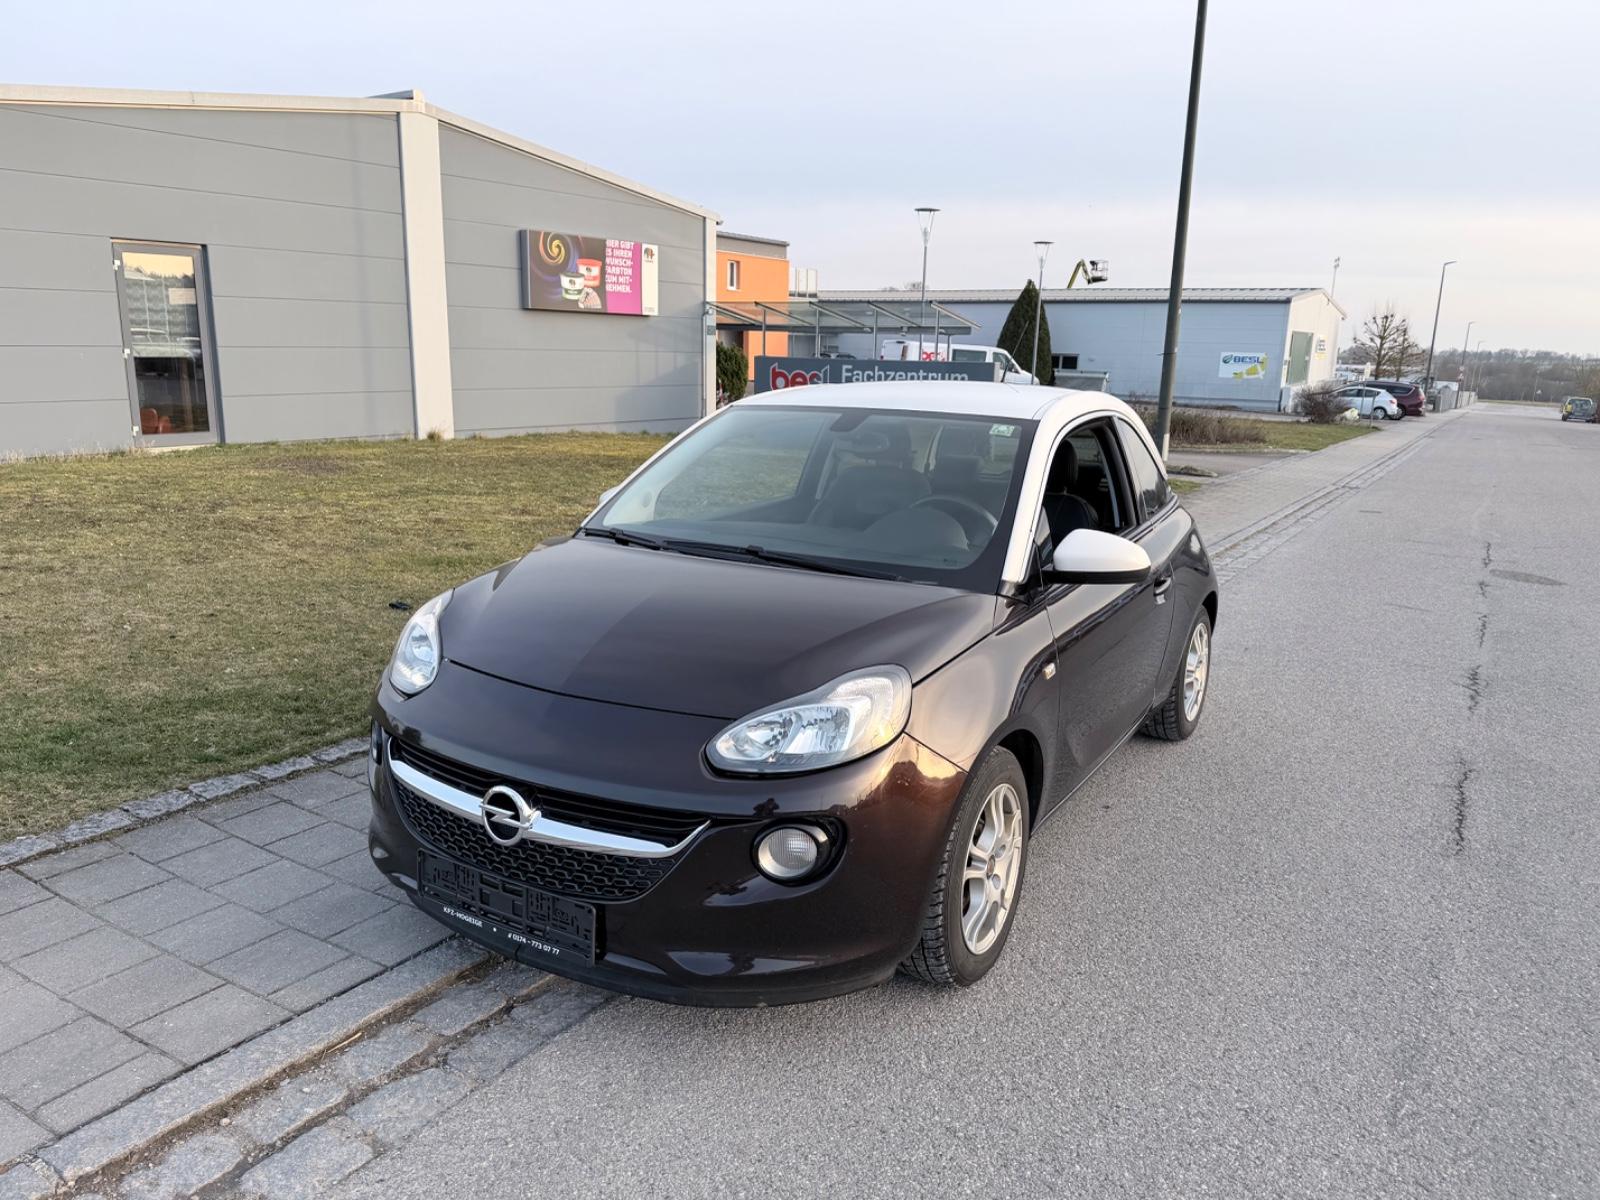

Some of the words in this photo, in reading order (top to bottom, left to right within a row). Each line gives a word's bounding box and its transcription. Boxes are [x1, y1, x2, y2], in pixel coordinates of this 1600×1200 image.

[620, 241, 634, 250] GIBT
[613, 249, 632, 258] IHREN
[606, 257, 633, 267] WUNSCH-
[606, 266, 632, 276] FARBTON
[605, 274, 617, 284] ZUM
[618, 276, 632, 285] MIT-
[606, 284, 632, 293] NEHMEN.
[1233, 356, 1264, 364] BESL
[841, 364, 969, 383] Fachzentrum
